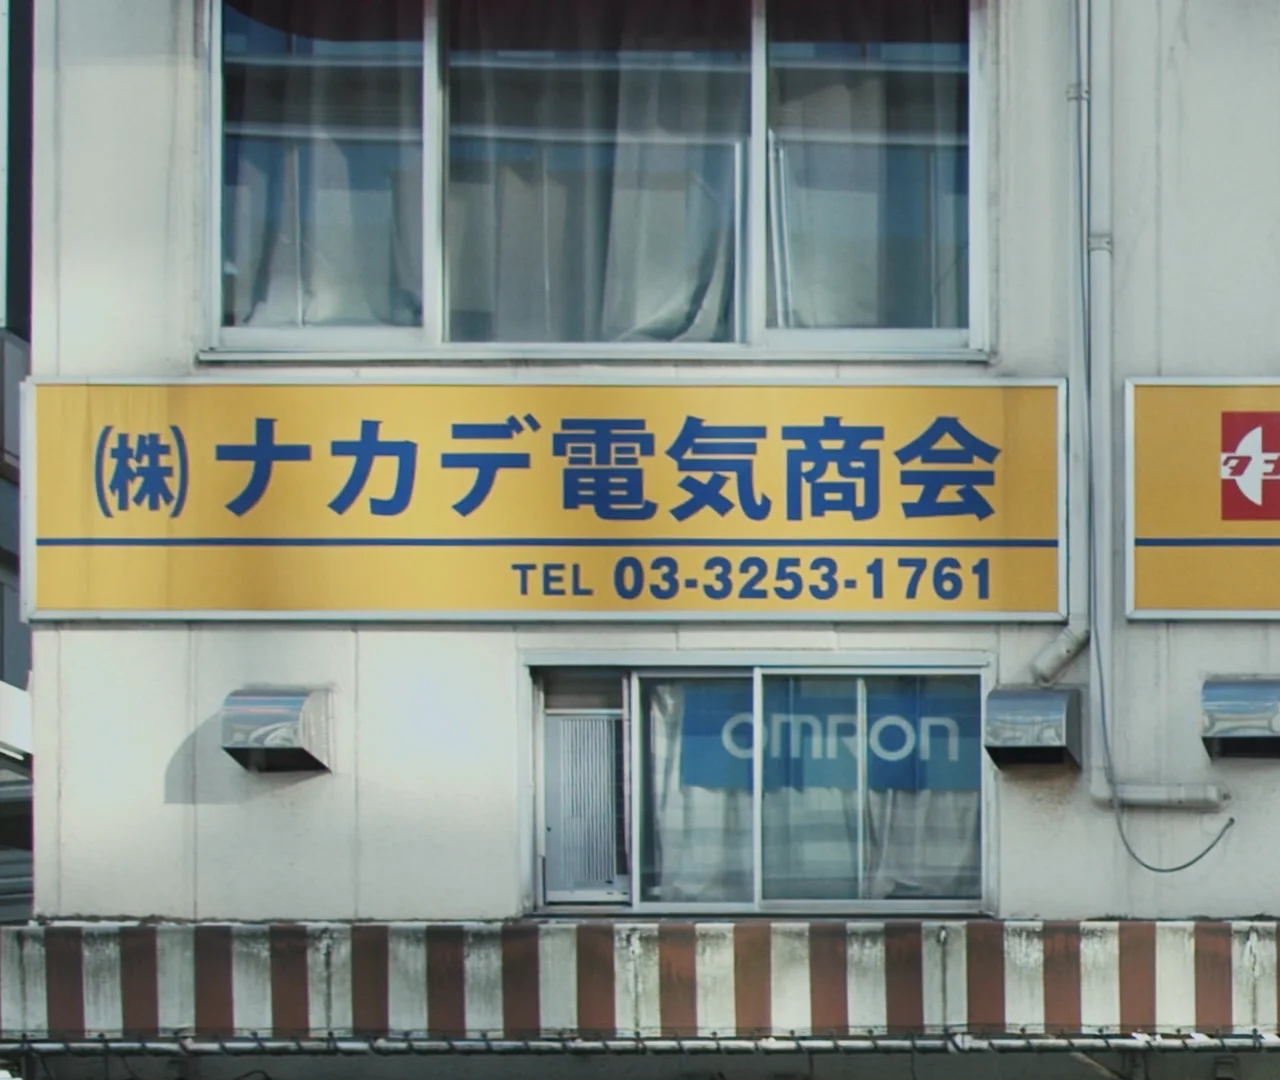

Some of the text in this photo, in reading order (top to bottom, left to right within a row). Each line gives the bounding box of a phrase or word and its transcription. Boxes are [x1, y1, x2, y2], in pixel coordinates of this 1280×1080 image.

[94, 416, 1000, 522] (株)ナカデ電気商会
[512, 557, 990, 601] TEL 03-3253-1761
